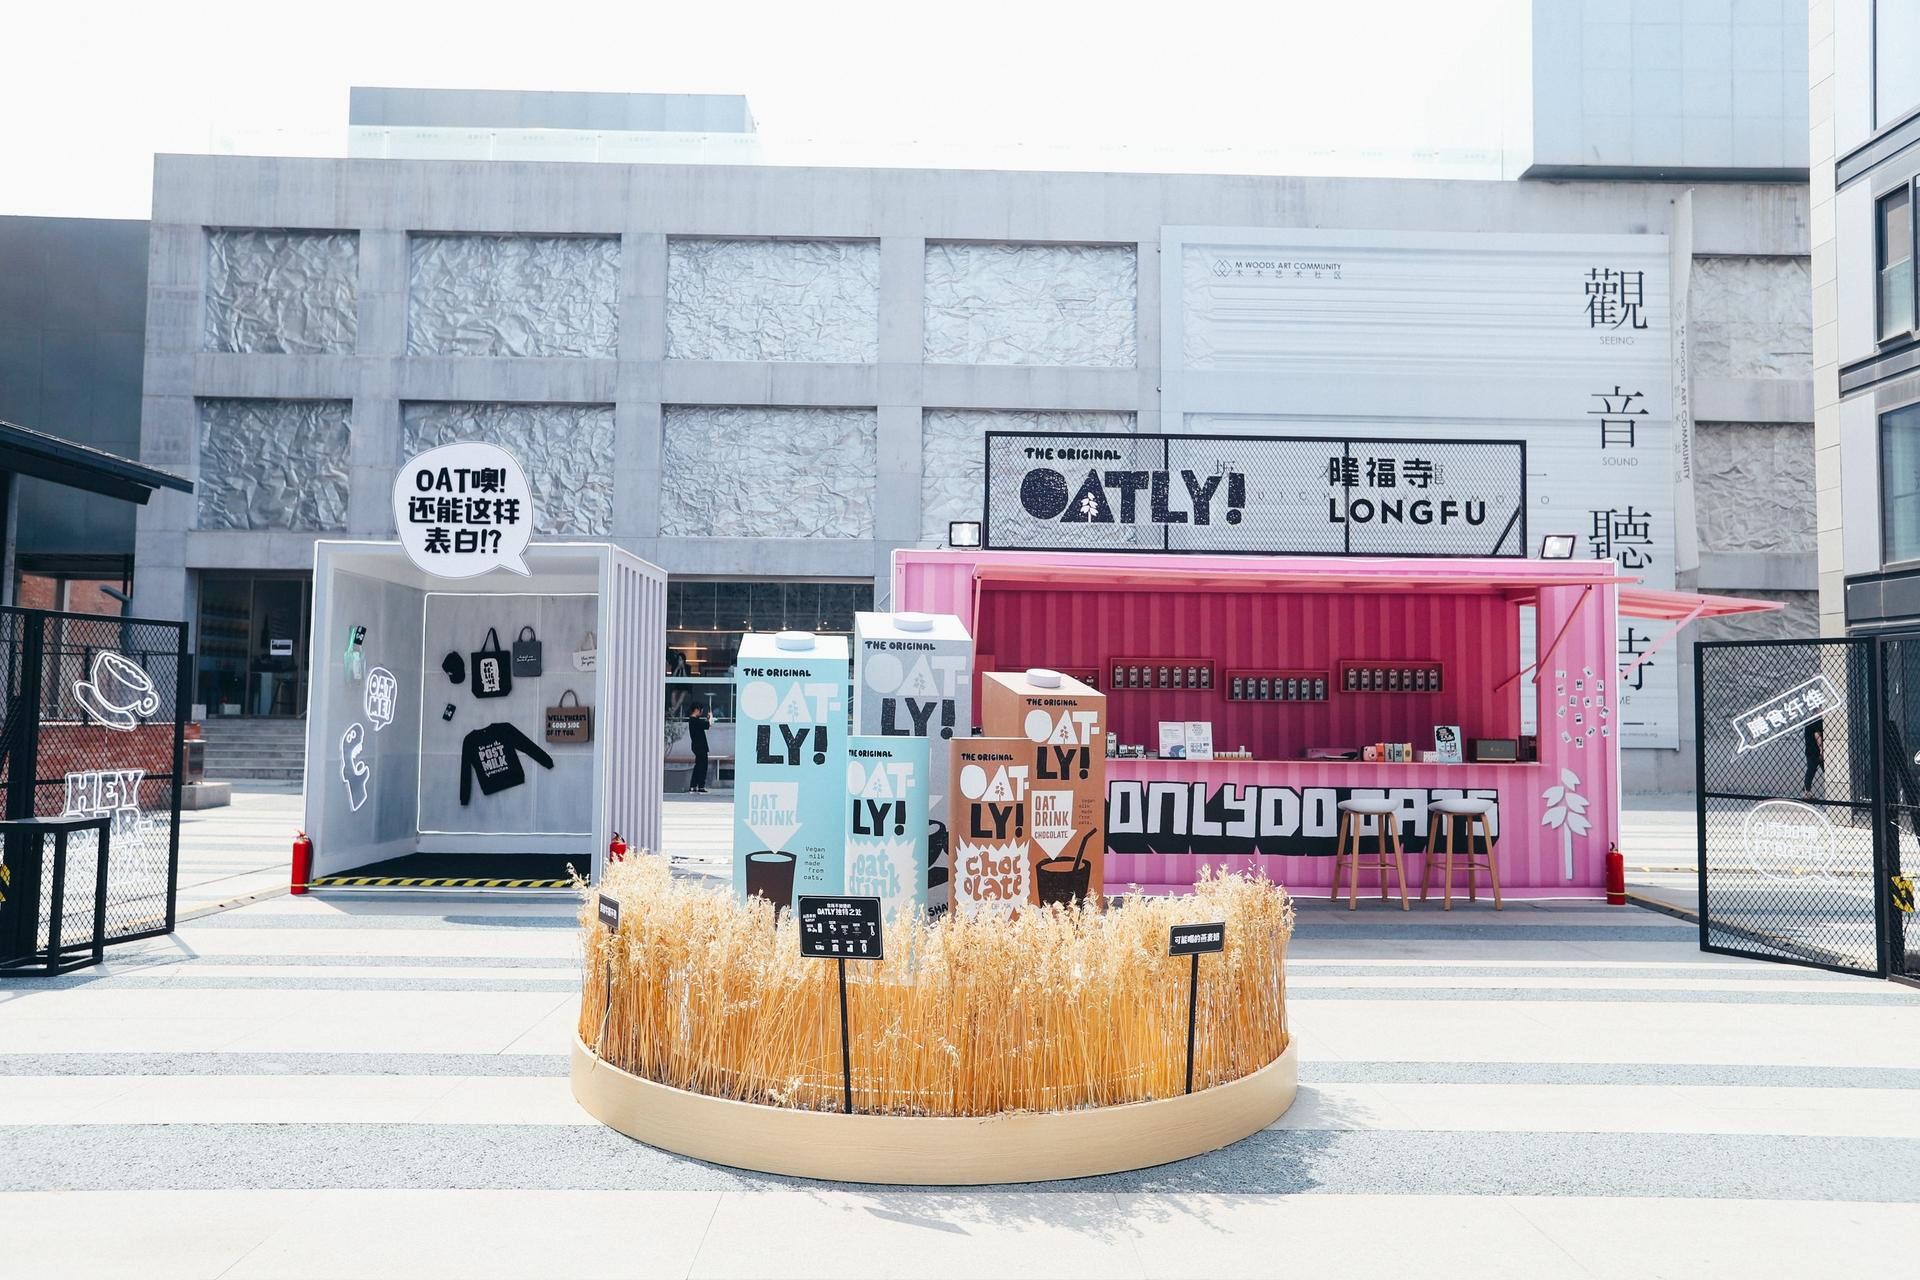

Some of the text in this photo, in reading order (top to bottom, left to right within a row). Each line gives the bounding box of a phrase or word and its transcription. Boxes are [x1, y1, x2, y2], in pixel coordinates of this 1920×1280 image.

[1235, 261, 1243, 269] M
[1245, 261, 1275, 269] WOODS
[1294, 262, 1342, 270] COMMUNITY
[1584, 268, 1648, 331] 觀
[1599, 336, 1635, 345] SEEING
[1587, 386, 1649, 449] 音
[1024, 447, 1121, 460] THE ORIGINAL
[1602, 457, 1639, 467] SOUND
[1329, 456, 1433, 488] 隆福寺
[1020, 468, 1246, 526] OATLY!
[408, 496, 520, 525] 还能这样
[1329, 498, 1486, 526] LONGFU
[864, 641, 936, 651] THE ORIGINAL
[743, 668, 812, 677] THE ORIGINAL
[1026, 698, 1042, 706] THE
[881, 697, 956, 740] LY!
[478, 744, 504, 762] POST
[756, 724, 828, 766] LY!
[849, 749, 893, 758] THE ORIGINAL
[961, 753, 1014, 761] THE ORIGINAL
[481, 754, 508, 772] MILK
[1037, 746, 1090, 780] LY!
[66, 770, 144, 813] HEY
[751, 794, 778, 810] OAT
[1035, 796, 1056, 810] OAT
[750, 810, 795, 826] DRINK
[853, 799, 907, 837] LY!
[970, 802, 1024, 839] LY!
[1034, 811, 1069, 827] DRINK
[1034, 830, 1068, 839] CHOCOLATE
[928, 902, 948, 917] SHA
